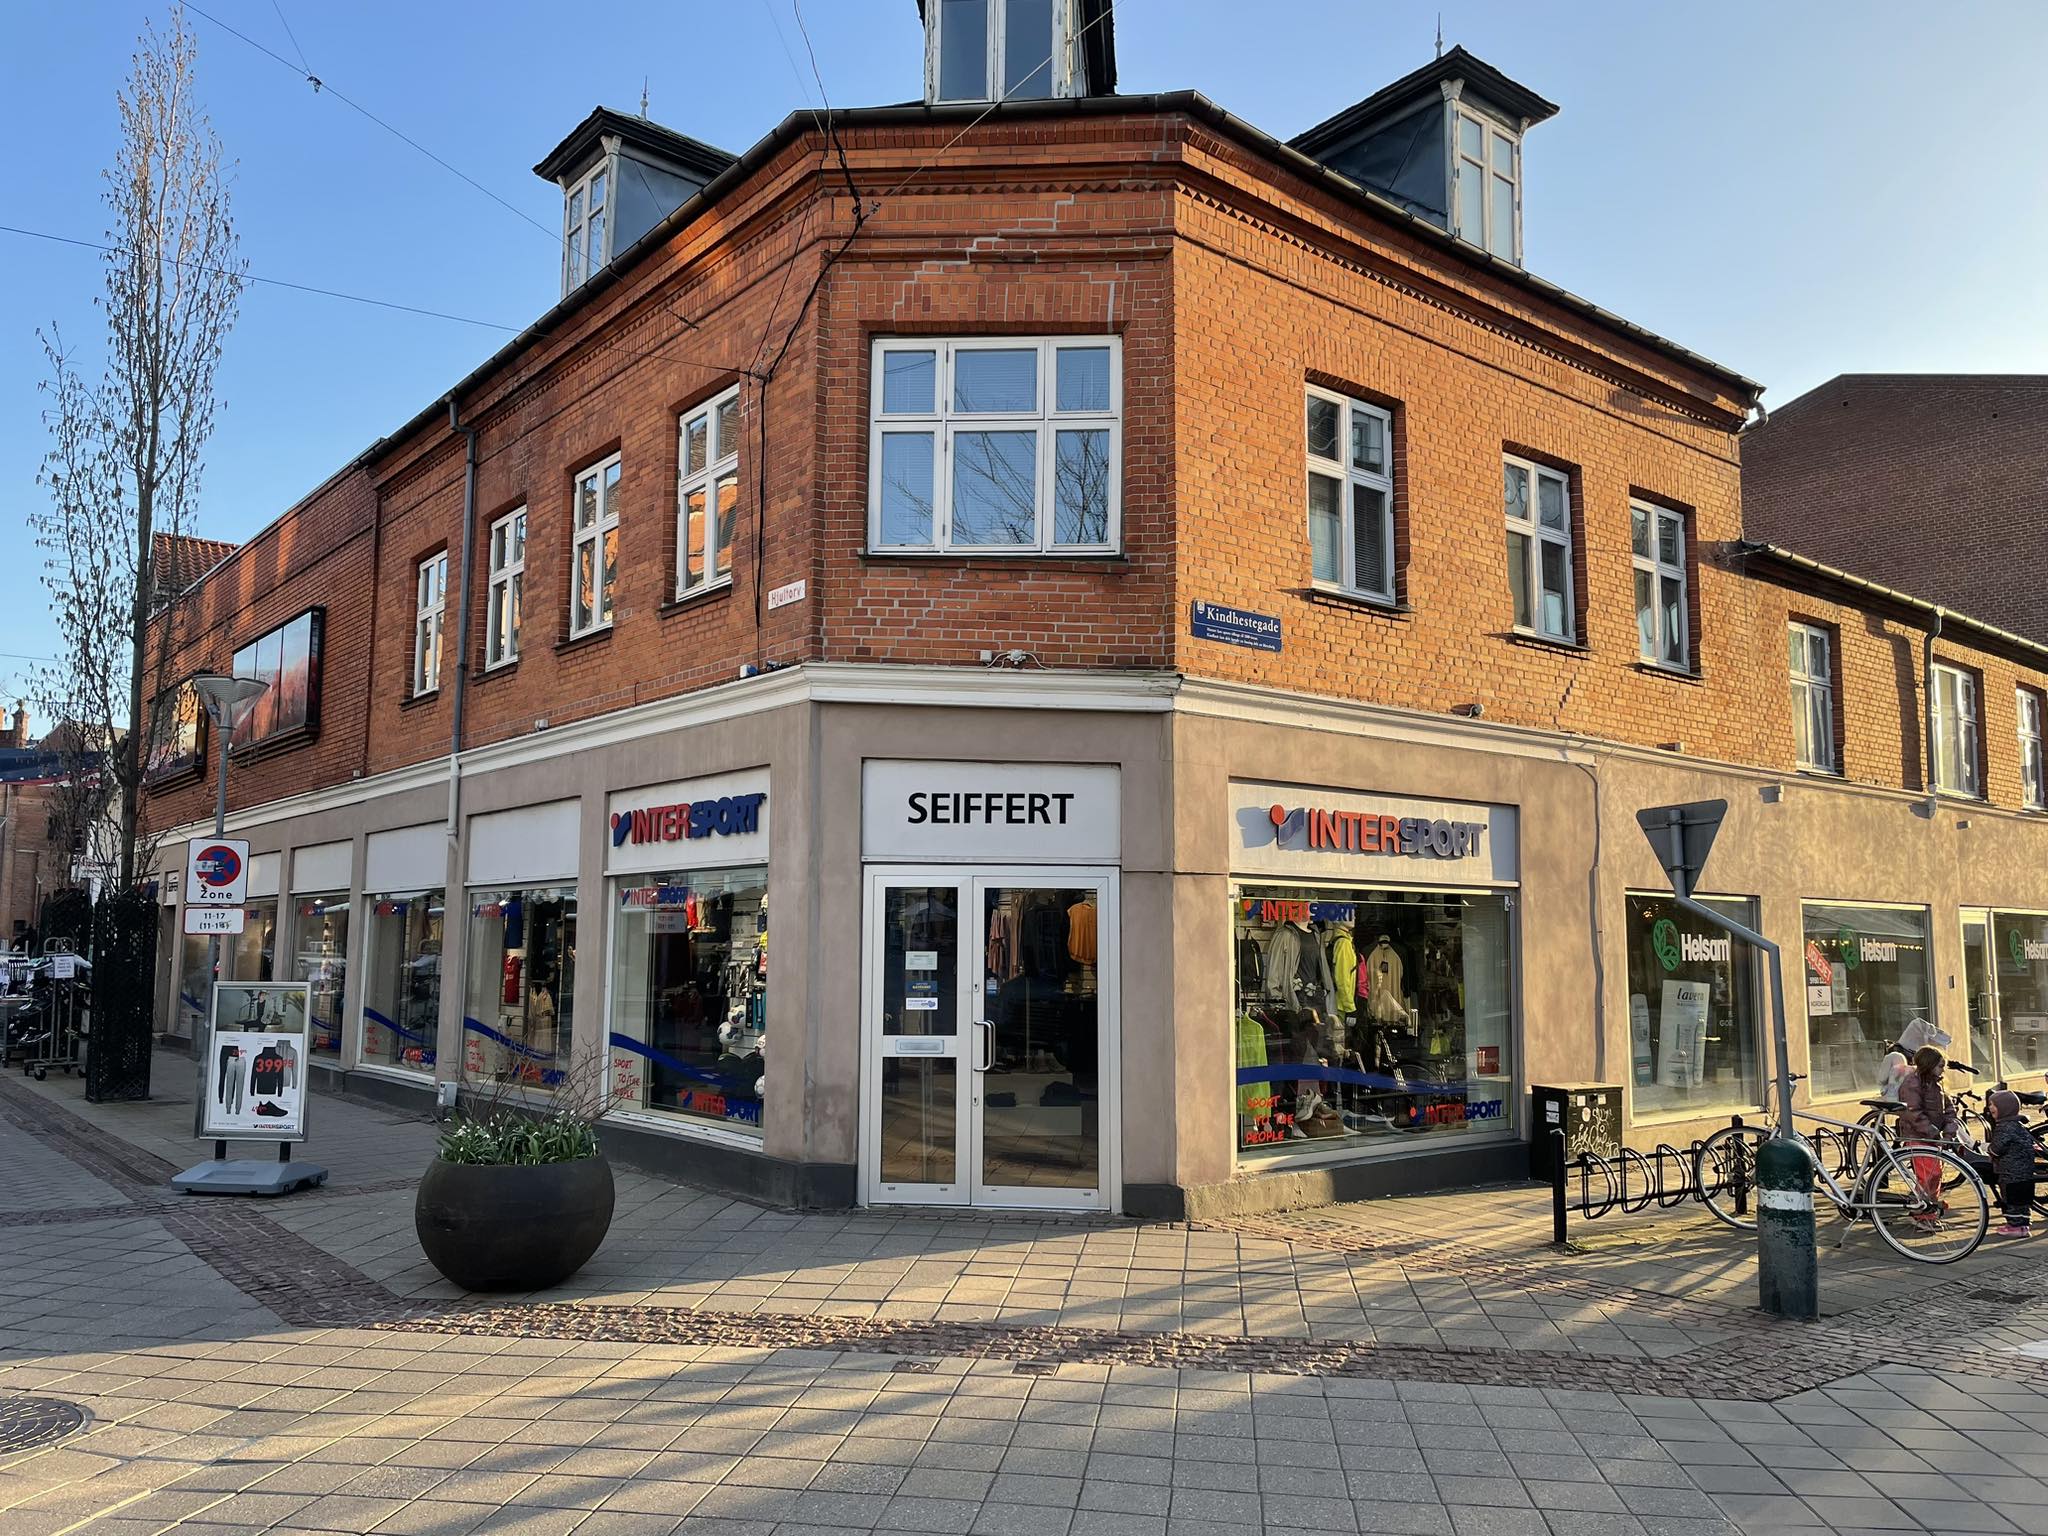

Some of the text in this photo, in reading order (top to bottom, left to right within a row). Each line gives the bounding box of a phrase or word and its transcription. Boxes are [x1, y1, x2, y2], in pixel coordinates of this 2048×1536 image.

[1206, 606, 1279, 633] Kindhestegade
[631, 793, 764, 845] INTERSPORT
[907, 792, 1075, 824] SEIFFERT
[1308, 807, 1484, 858] INTERSPORT
[200, 889, 233, 899] Zone
[204, 912, 226, 920] 11-17
[1680, 933, 1730, 962] Helsam
[1859, 937, 1897, 962] Helsam
[613, 1058, 634, 1069] SPORT
[1254, 1114, 1270, 1127] TO
[1245, 1130, 1285, 1144] PEOPLE
